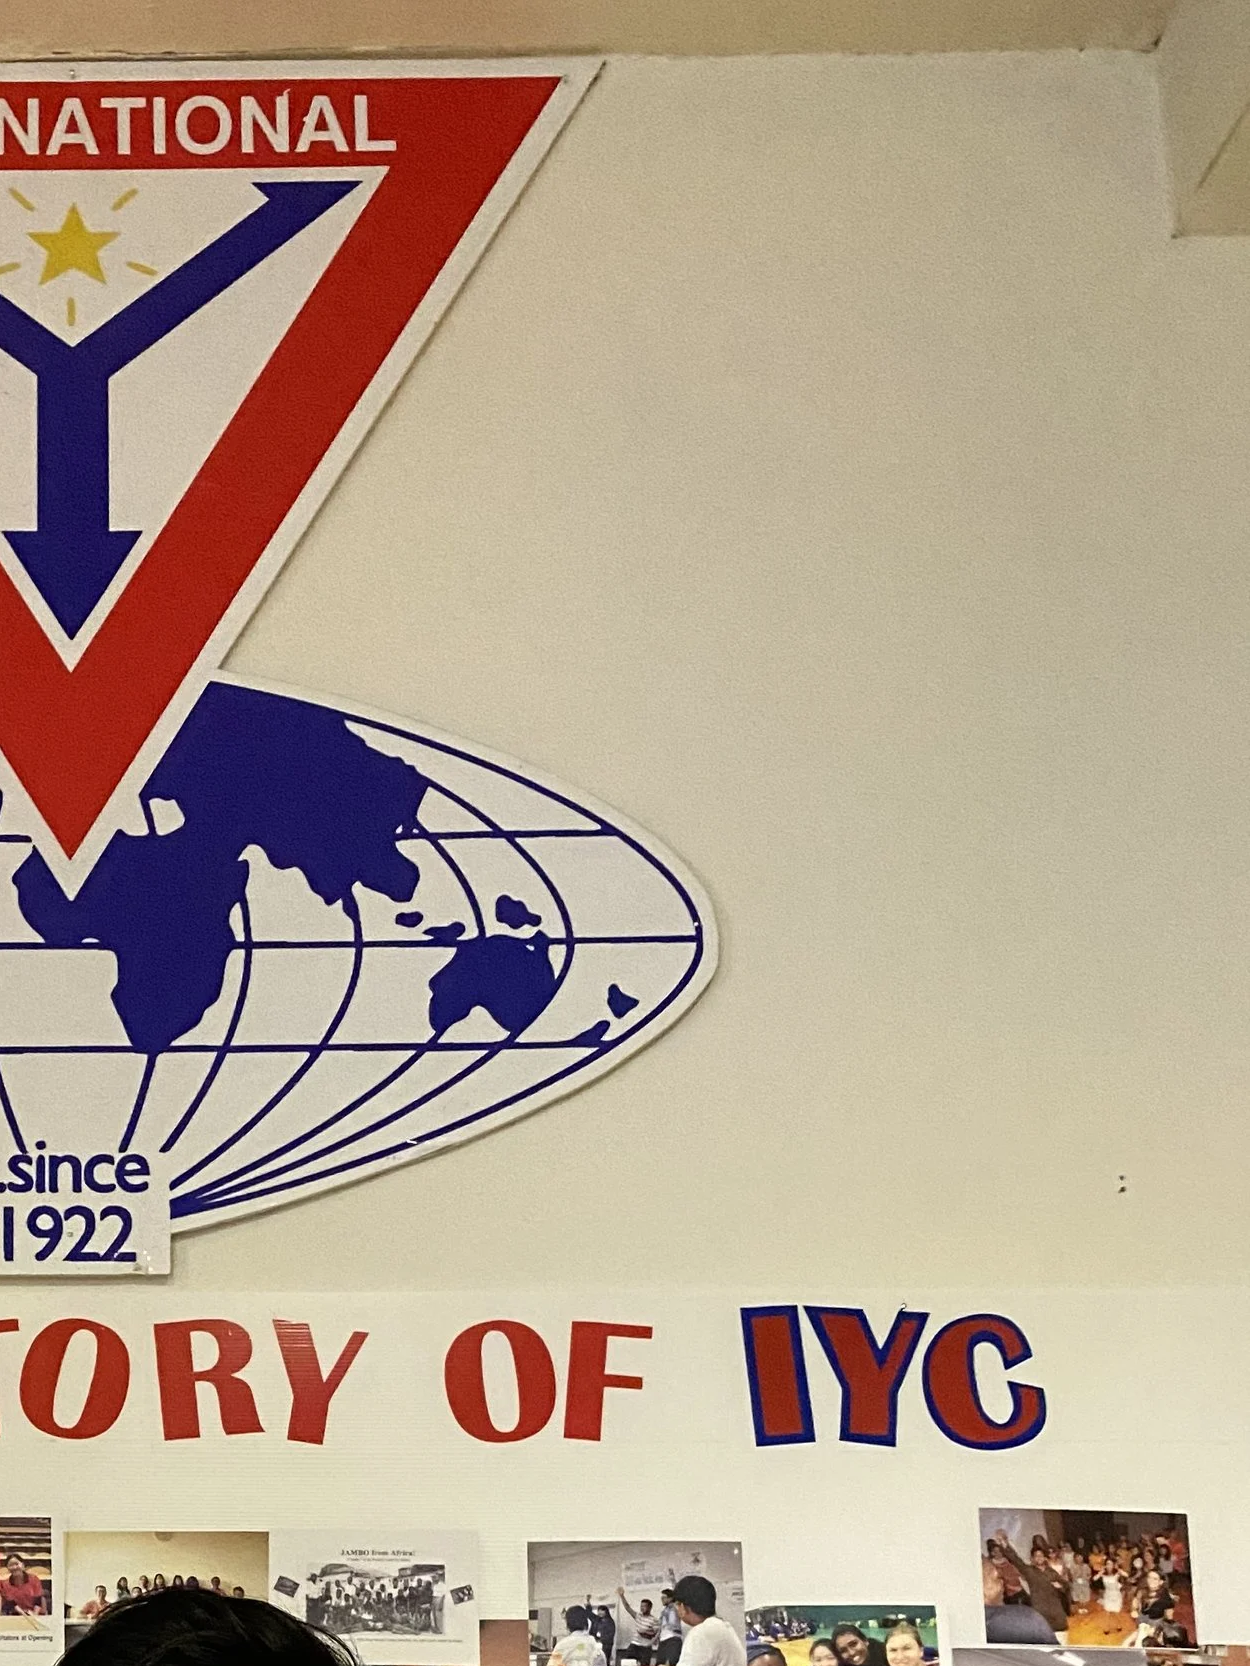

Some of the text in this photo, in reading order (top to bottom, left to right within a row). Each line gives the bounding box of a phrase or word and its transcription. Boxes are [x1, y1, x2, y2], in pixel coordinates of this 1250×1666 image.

[3, 1205, 137, 1262] 1922
[444, 1319, 654, 1443] OF
[740, 1303, 1047, 1450] IYC
